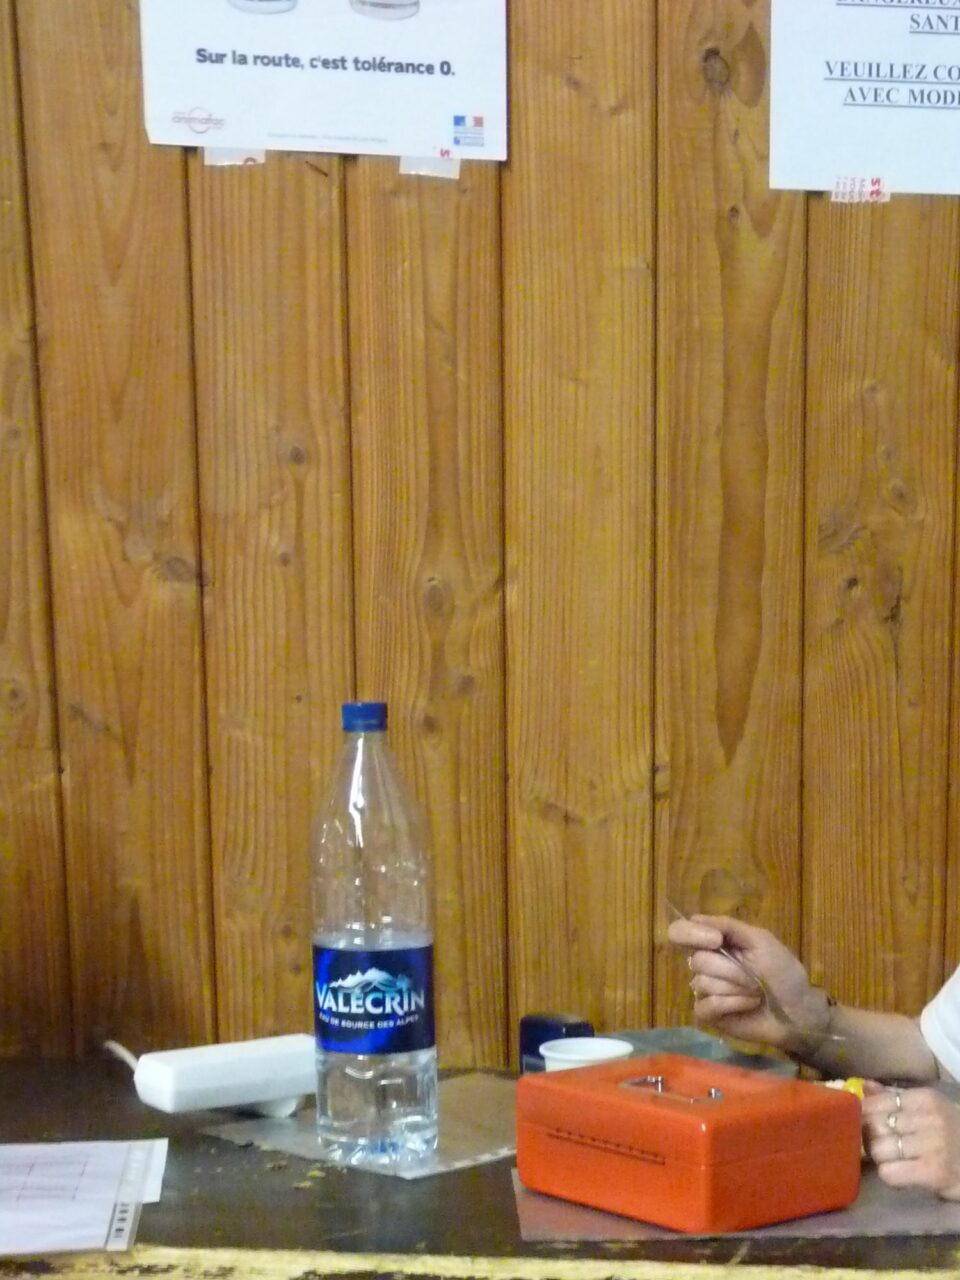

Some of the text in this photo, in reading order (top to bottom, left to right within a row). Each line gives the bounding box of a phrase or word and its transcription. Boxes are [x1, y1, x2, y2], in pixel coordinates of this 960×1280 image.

[196, 47, 228, 66] Sur
[232, 49, 249, 67] la
[253, 52, 305, 70] route,
[309, 54, 349, 71] c'est
[353, 55, 435, 76] tolérance
[824, 60, 928, 81] VEUILLEZ
[843, 86, 901, 104] AVEC
